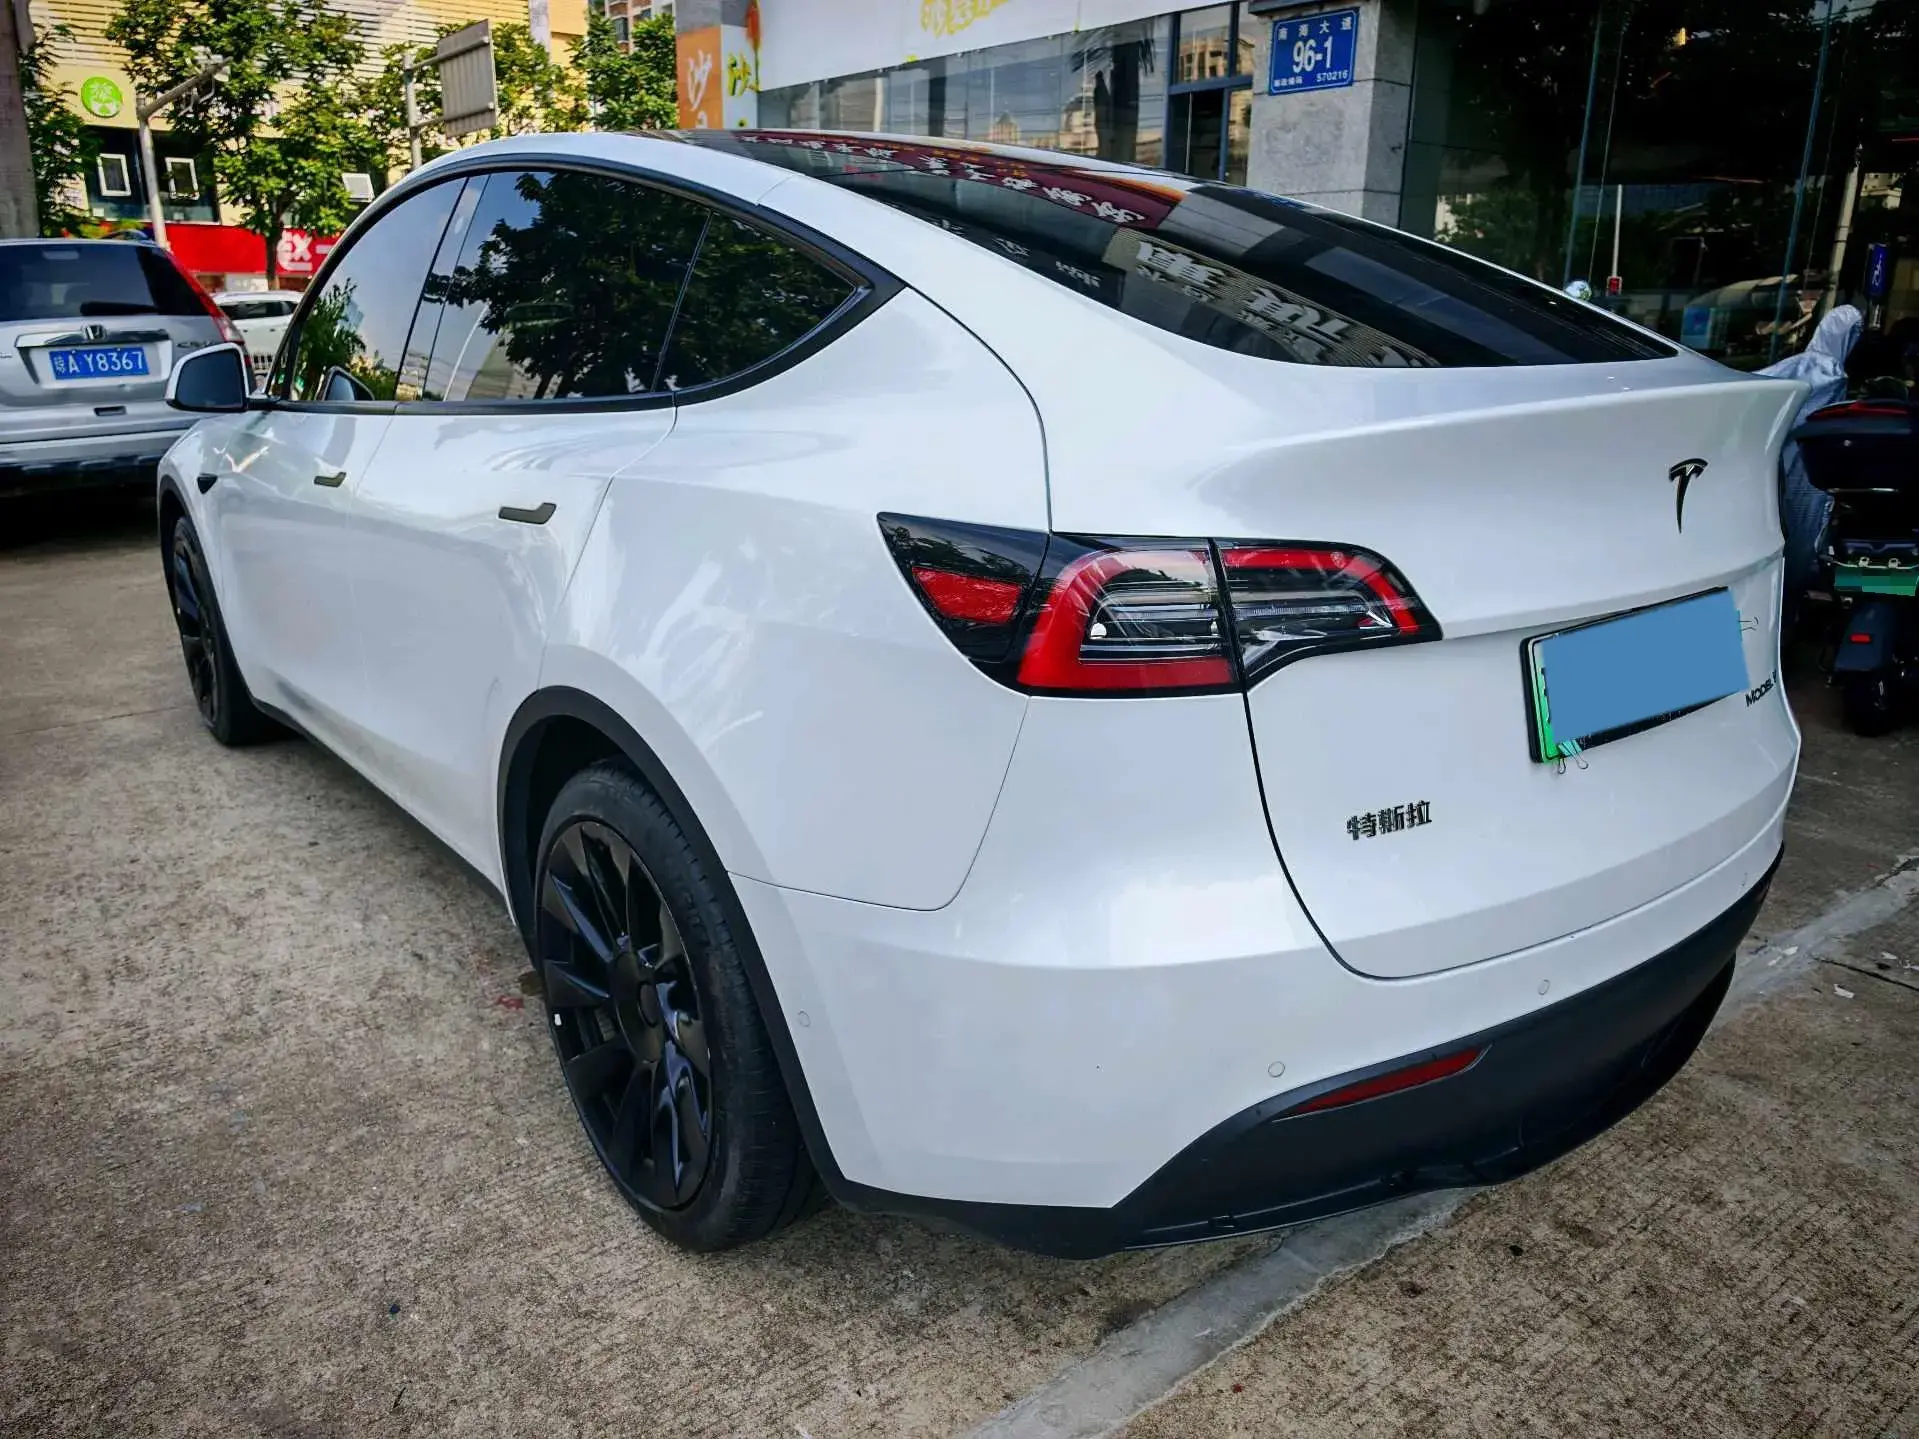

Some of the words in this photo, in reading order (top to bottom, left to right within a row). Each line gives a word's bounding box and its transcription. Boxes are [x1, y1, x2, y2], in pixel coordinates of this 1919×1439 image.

[1292, 35, 1333, 74] 96-1
[1346, 799, 1433, 841] 特斯拉
